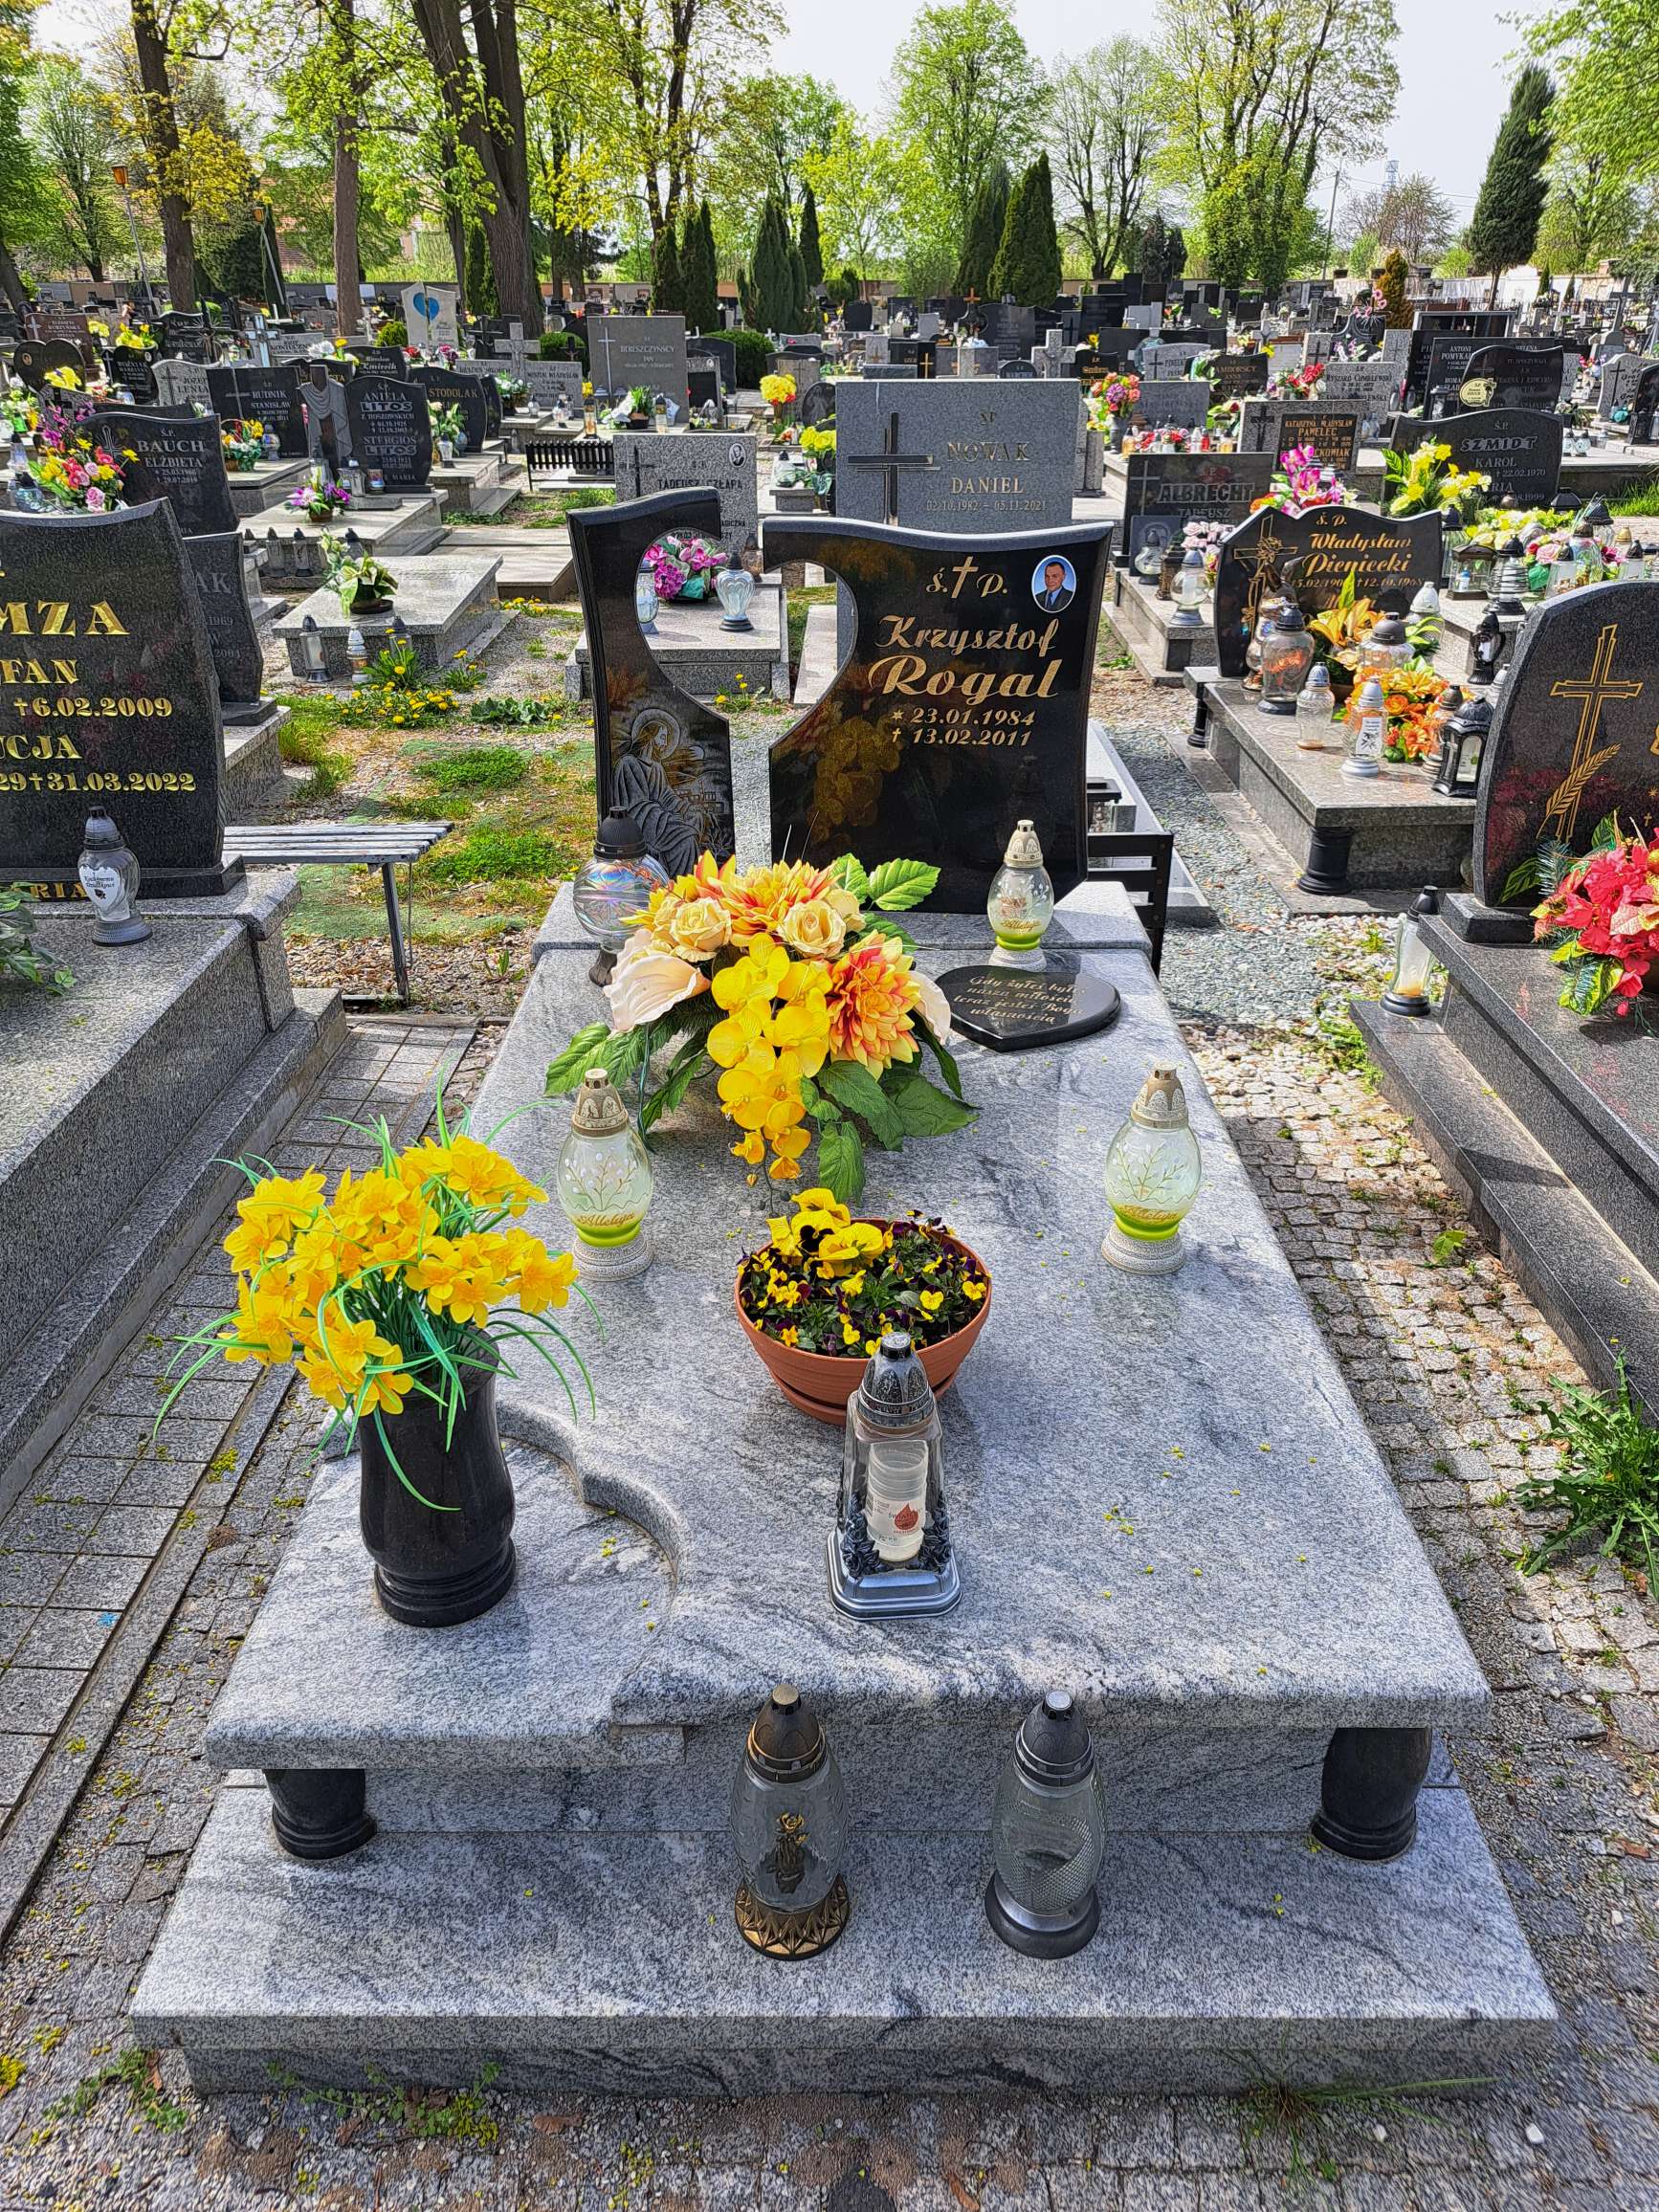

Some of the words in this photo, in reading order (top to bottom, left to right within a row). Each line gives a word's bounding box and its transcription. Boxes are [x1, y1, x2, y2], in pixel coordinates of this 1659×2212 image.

[252, 389, 287, 399] RUDNIK
[364, 391, 408, 401] ANIELA
[360, 401, 413, 412] LITOS
[1297, 427, 1338, 436] PAWELEC
[137, 440, 206, 453] BAUCH
[365, 445, 417, 455] LITOS
[946, 441, 1030, 462] NOWAK
[1460, 435, 1538, 453] SZMIDT
[1314, 448, 1351, 457] CKOWIAK
[144, 455, 204, 468] ELŻBIETA
[1474, 456, 1517, 468] KAROL
[949, 477, 1027, 495] DANIEL
[1156, 483, 1255, 504] ALBRECHT
[1178, 508, 1232, 519] TADEUSZ
[1309, 532, 1414, 552] Władysław
[1301, 552, 1412, 577] Pieniecki
[874, 615, 1060, 658] Krzysztof
[868, 654, 1064, 706] Rogal
[910, 707, 1037, 726] 23.01.1984
[913, 727, 1033, 746] 13.02.2011
[969, 976, 1003, 988] Gdy
[953, 995, 992, 1006] teraz
[1041, 1003, 1084, 1016] Boga
